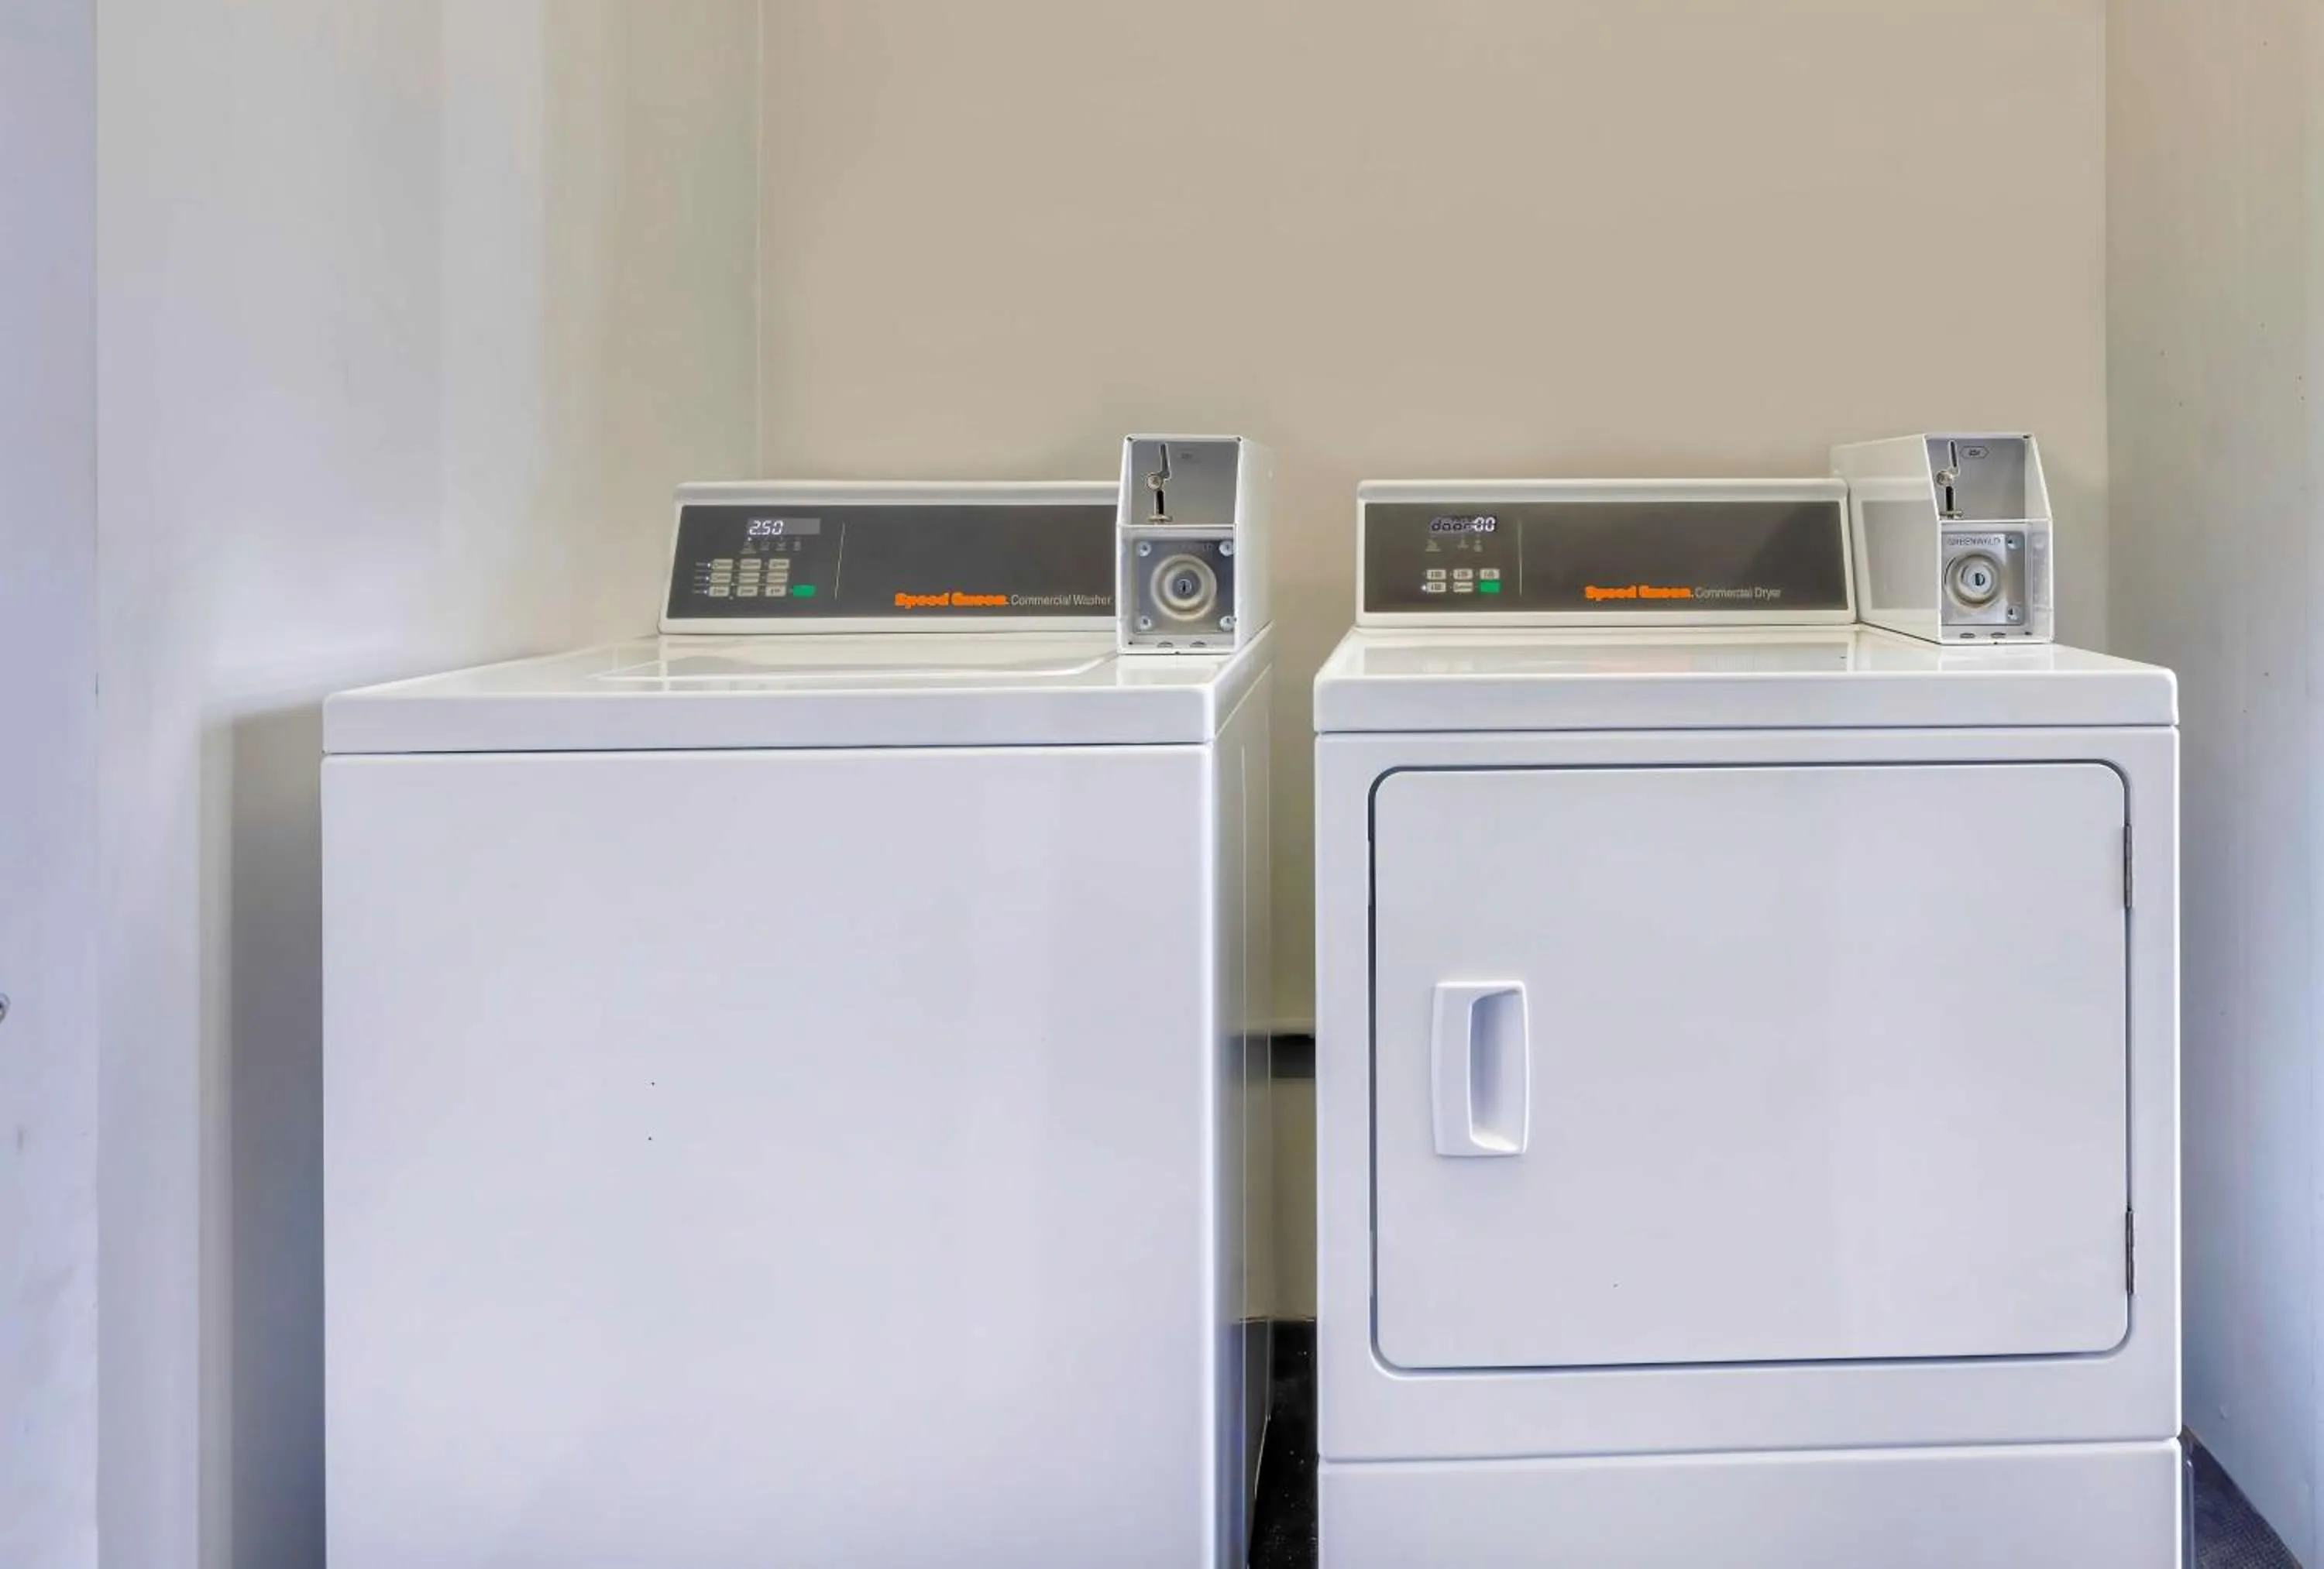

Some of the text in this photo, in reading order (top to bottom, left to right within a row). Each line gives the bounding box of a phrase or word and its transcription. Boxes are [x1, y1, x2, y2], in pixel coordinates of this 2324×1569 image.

[748, 520, 784, 535] 2.50
[894, 592, 950, 609] Speed
[1011, 593, 1071, 606] Commercial
[1074, 593, 1112, 606] Washer
[1585, 585, 1637, 602] Speed
[1695, 586, 1752, 599] Commercial
[1755, 586, 1781, 601] Dryer
